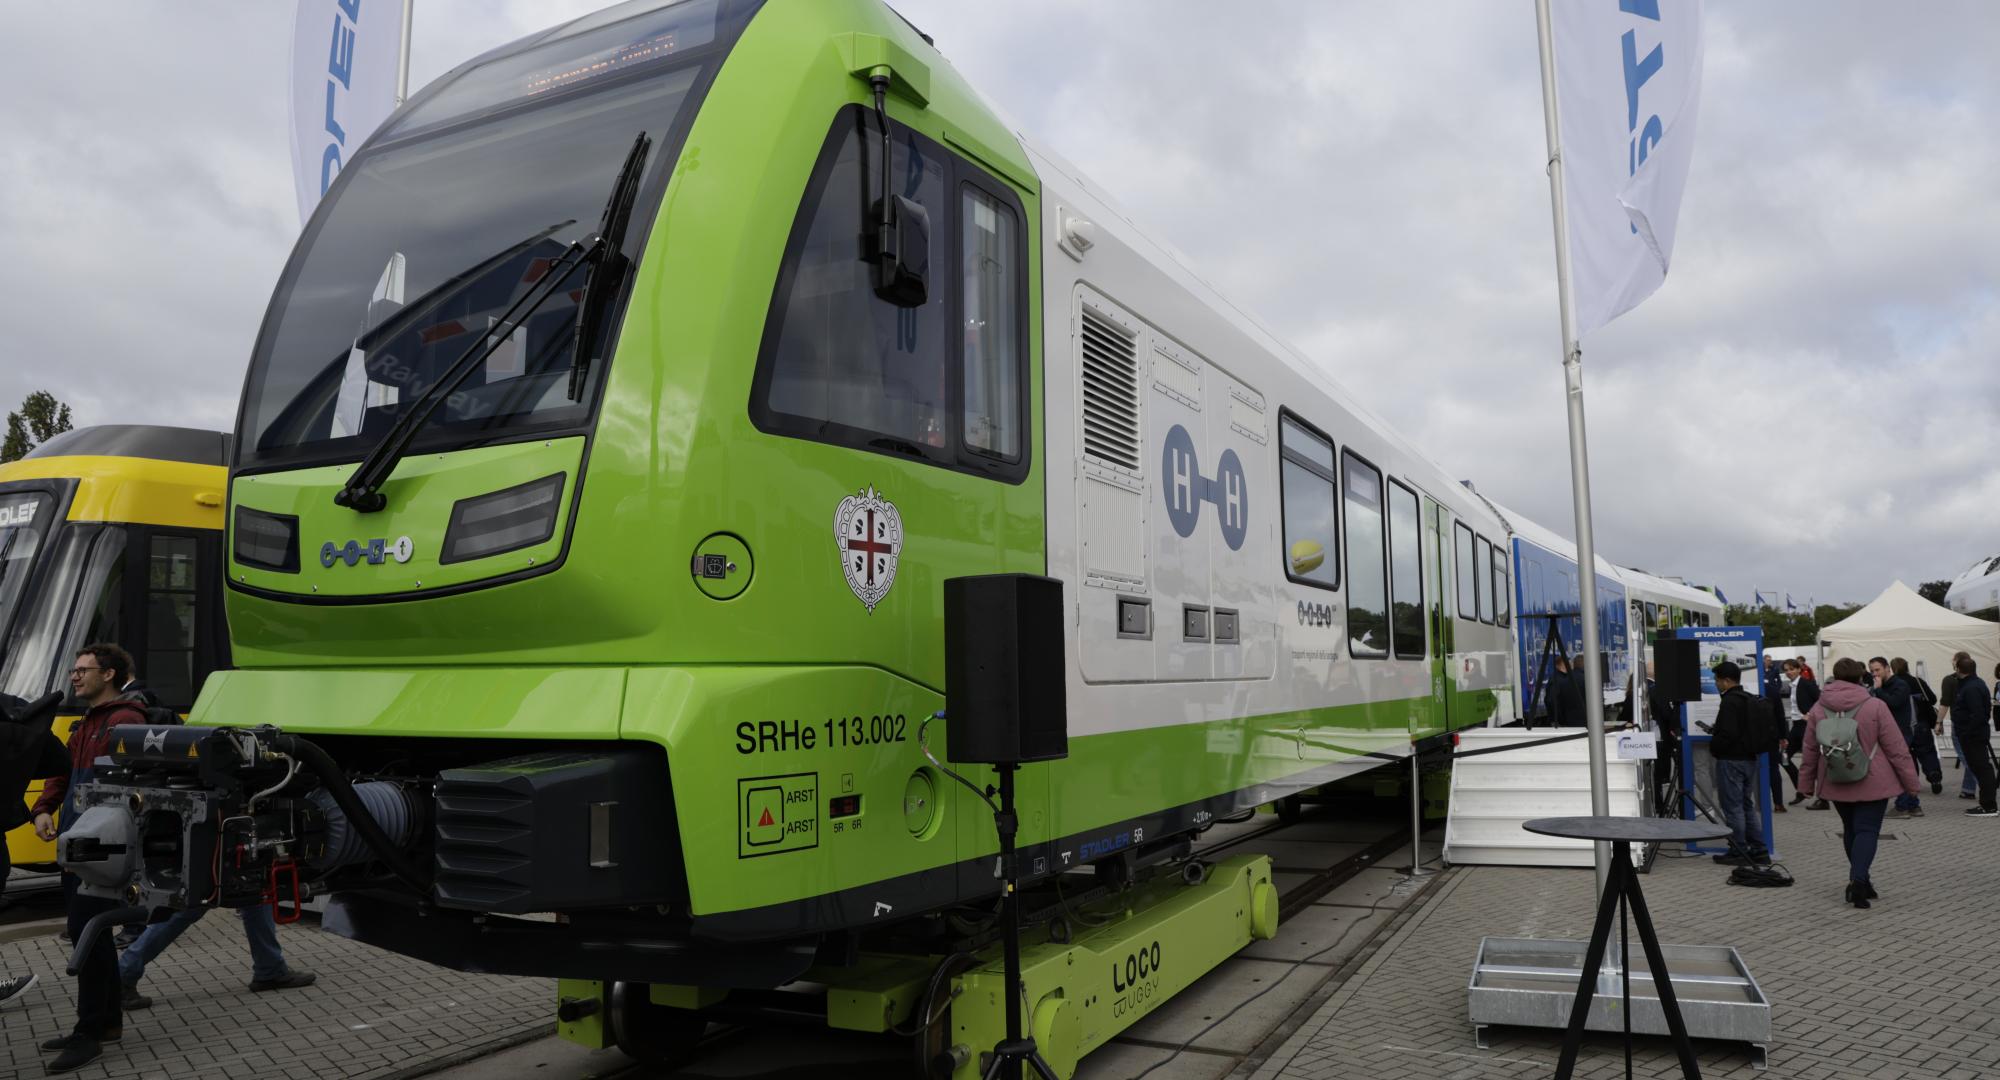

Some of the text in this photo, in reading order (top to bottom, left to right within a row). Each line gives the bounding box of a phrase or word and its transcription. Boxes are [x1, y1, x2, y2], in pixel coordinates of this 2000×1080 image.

[1694, 630, 1745, 638] STADLER
[735, 714, 907, 755] SRHe 113.002
[786, 788, 815, 804] ARST
[786, 818, 815, 834] ARST
[1079, 832, 1130, 859] STADLER
[1113, 940, 1160, 993] LOCO
